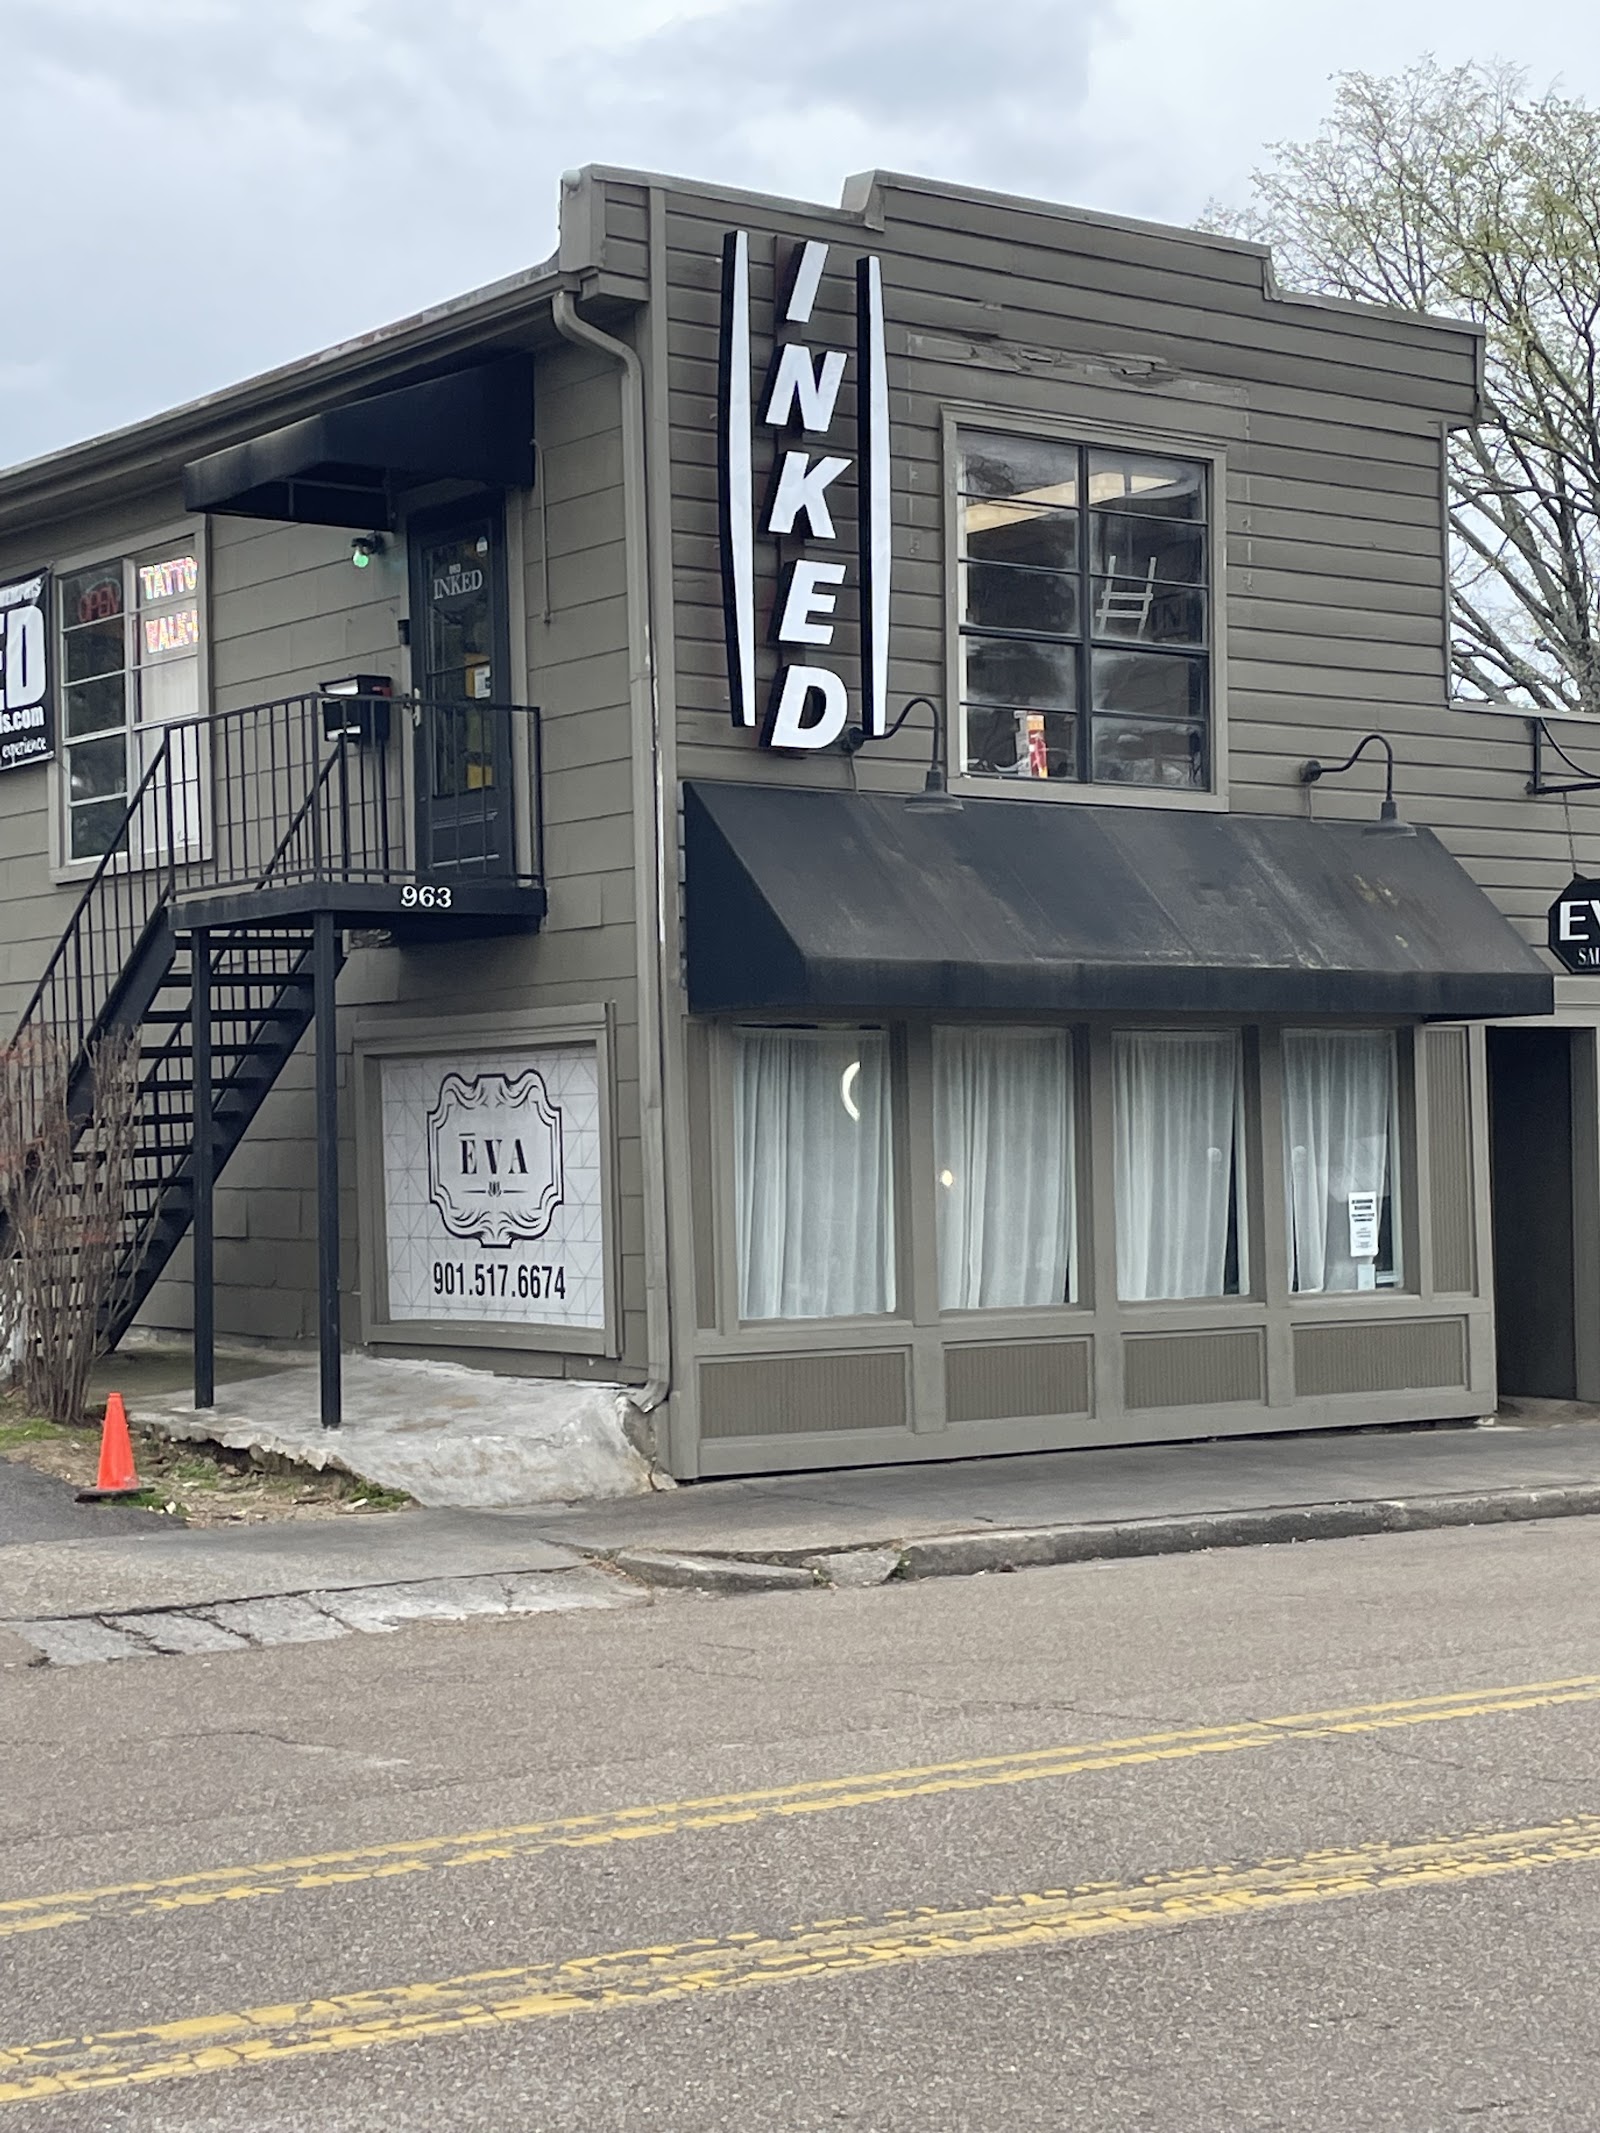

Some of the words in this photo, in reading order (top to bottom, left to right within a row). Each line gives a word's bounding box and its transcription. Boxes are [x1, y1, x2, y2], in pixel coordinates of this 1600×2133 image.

[764, 238, 855, 751] INKED
[79, 584, 119, 622] OPEN
[433, 569, 483, 600] INKED
[400, 885, 452, 908] 963
[433, 1260, 566, 1300] 901.517.6674
